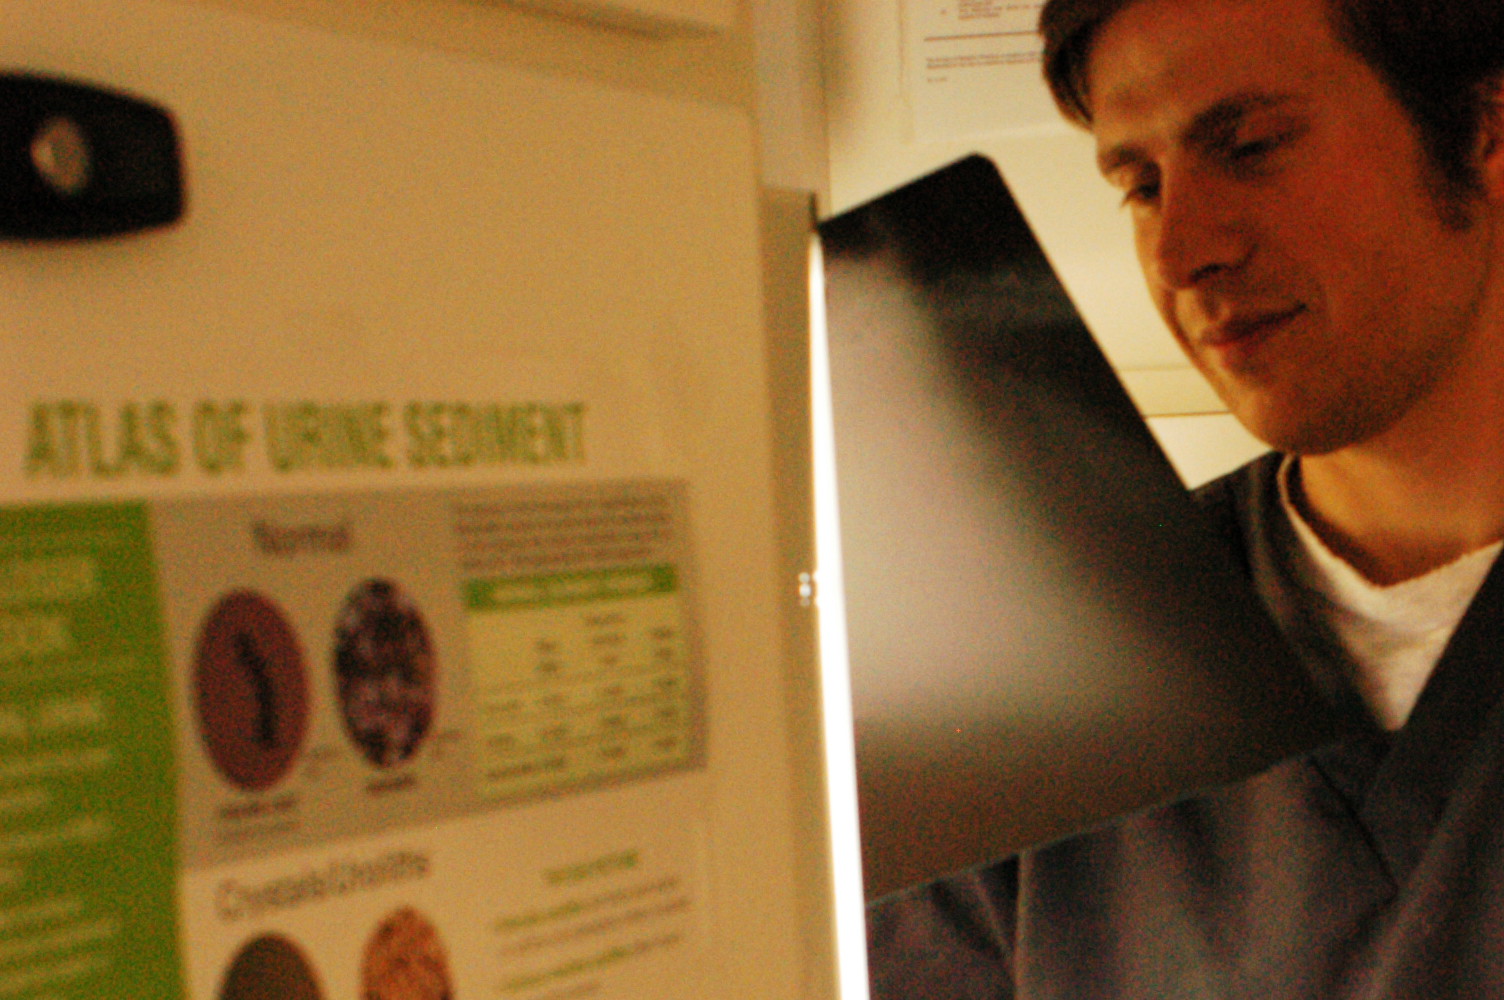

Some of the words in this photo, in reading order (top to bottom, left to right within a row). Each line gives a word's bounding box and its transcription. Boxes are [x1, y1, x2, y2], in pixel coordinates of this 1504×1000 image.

[24, 398, 183, 478] ATLAS
[192, 398, 252, 476] OF
[260, 398, 395, 473] URINE
[402, 400, 588, 469] SEDIMENT
